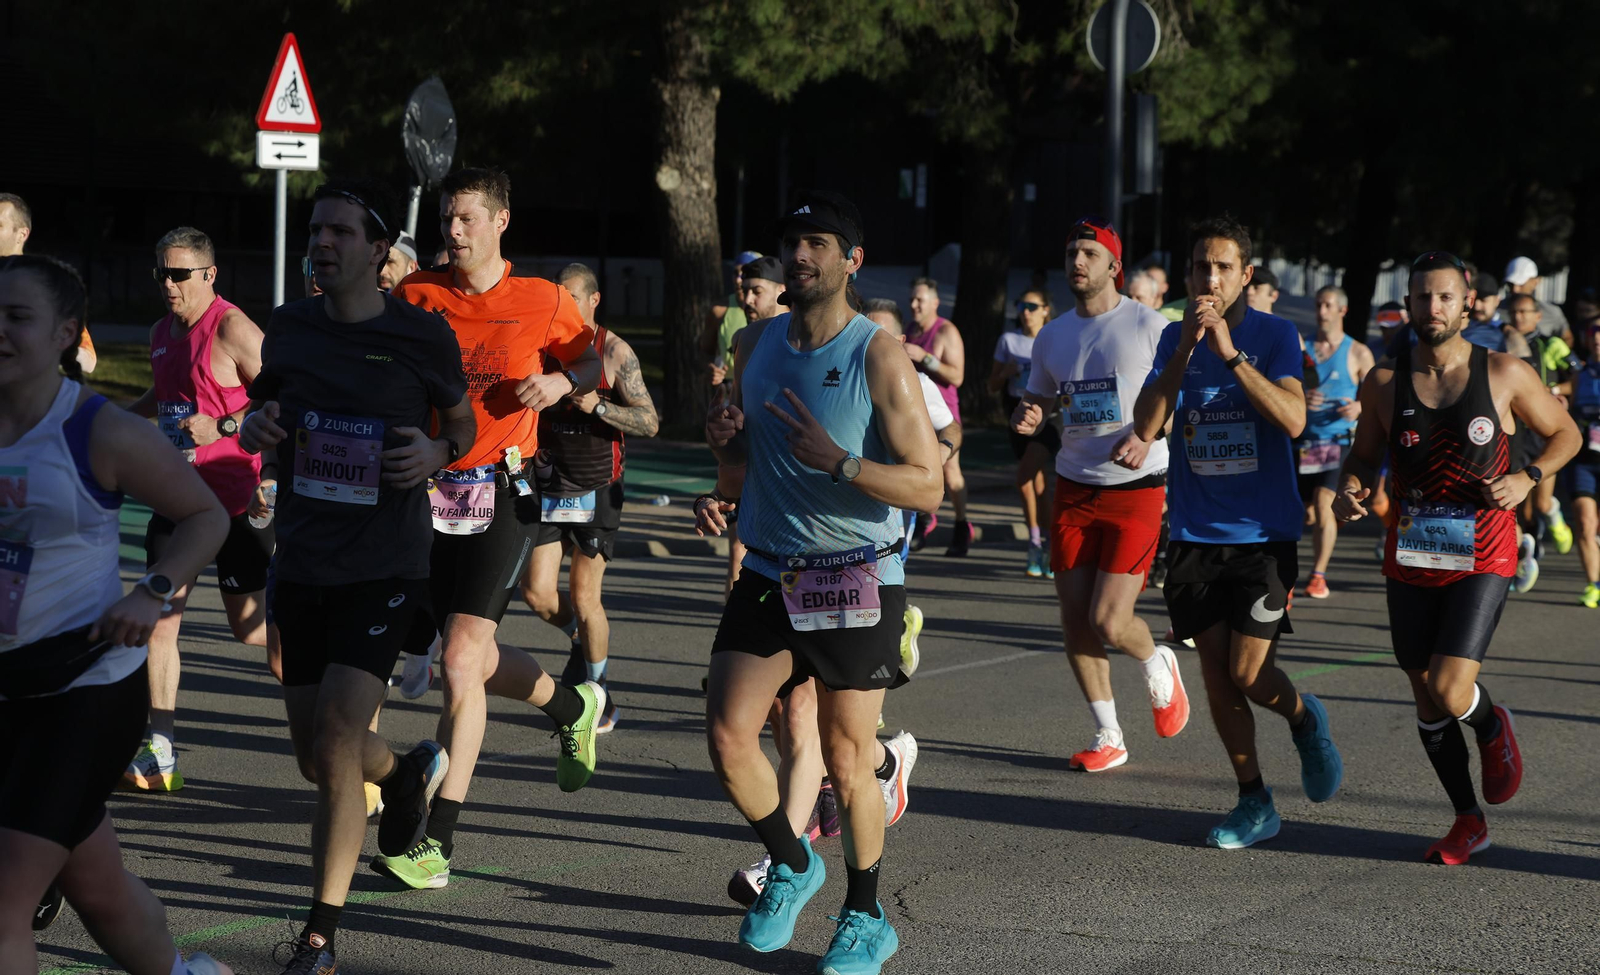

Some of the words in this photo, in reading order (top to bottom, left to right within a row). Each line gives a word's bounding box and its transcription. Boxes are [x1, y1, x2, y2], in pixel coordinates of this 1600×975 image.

[465, 373, 502, 383] ORRER
[1079, 382, 1111, 391] ZURICH
[161, 404, 190, 414] ZURICH
[1081, 400, 1099, 408] 5515
[1070, 409, 1115, 423] NICOLAS
[1204, 410, 1245, 422] ZURICH
[324, 418, 373, 435] ZURICH
[1207, 431, 1228, 441] 5858
[321, 443, 347, 458] 9425
[1187, 445, 1208, 458] RUI
[1211, 442, 1254, 458] LOPES
[303, 457, 368, 482] ARNOUT
[447, 490, 470, 500] 9353
[446, 507, 493, 518] FANCLUB
[1424, 506, 1467, 517] ZURICH
[1424, 525, 1447, 535] 4843
[1398, 538, 1437, 551] JAVIER
[1440, 542, 1474, 555] ARIAS
[813, 551, 864, 567] ZURICH
[815, 574, 843, 586] 9187
[801, 588, 861, 609] EDGAR
